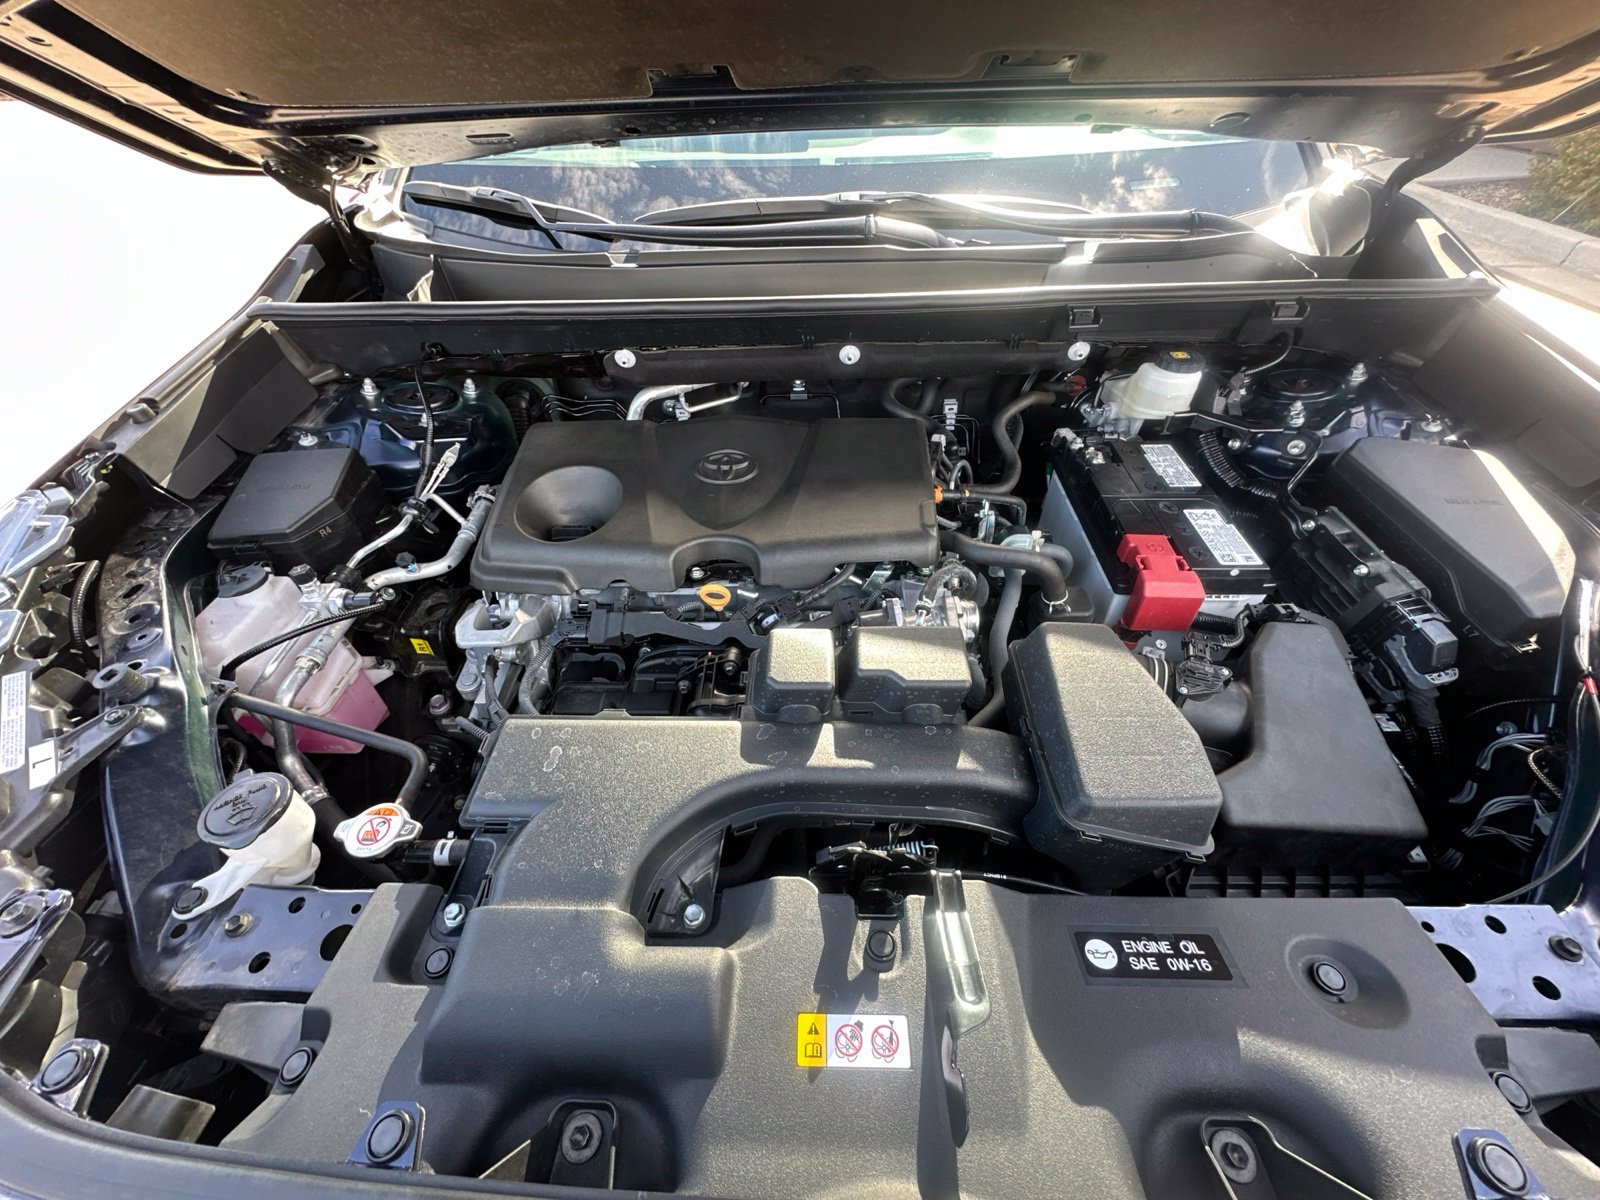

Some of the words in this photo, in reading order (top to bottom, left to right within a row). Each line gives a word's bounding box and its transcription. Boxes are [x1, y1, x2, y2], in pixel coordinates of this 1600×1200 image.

[319, 526, 332, 538] R4
[1121, 940, 1175, 954] ENGINE
[1179, 940, 1206, 955] OIL
[1128, 956, 1161, 971] SAE
[1166, 957, 1213, 972] 0W-16
